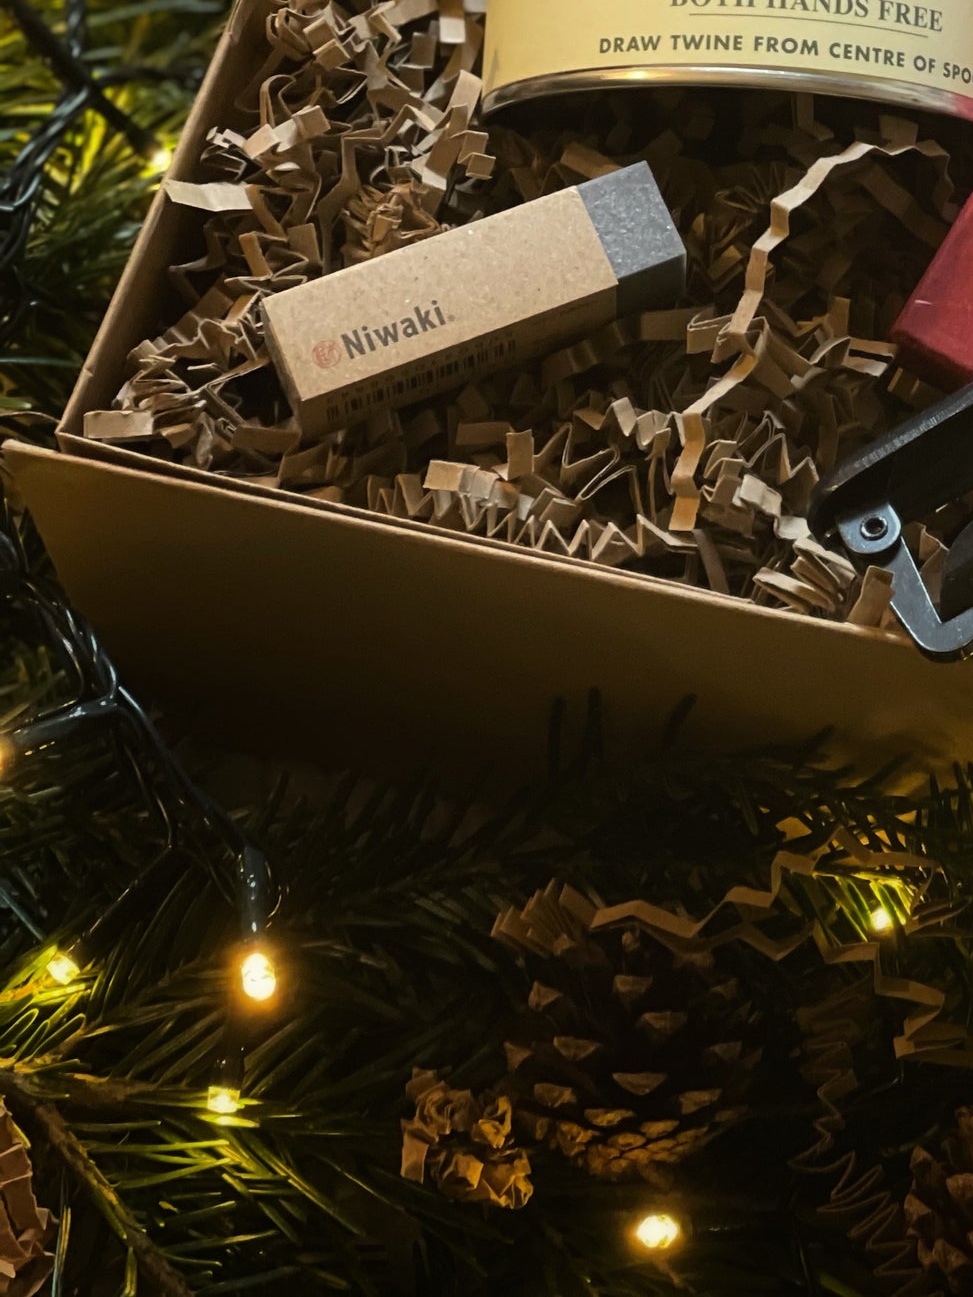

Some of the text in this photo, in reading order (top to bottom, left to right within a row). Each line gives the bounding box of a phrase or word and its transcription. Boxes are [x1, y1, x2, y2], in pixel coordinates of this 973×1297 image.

[877, 0, 943, 33] FREE
[599, 35, 661, 55] DRAW
[670, 33, 743, 52] TWINE
[753, 35, 820, 58] FROM
[829, 42, 906, 68] CENTRE
[914, 54, 937, 74] OF
